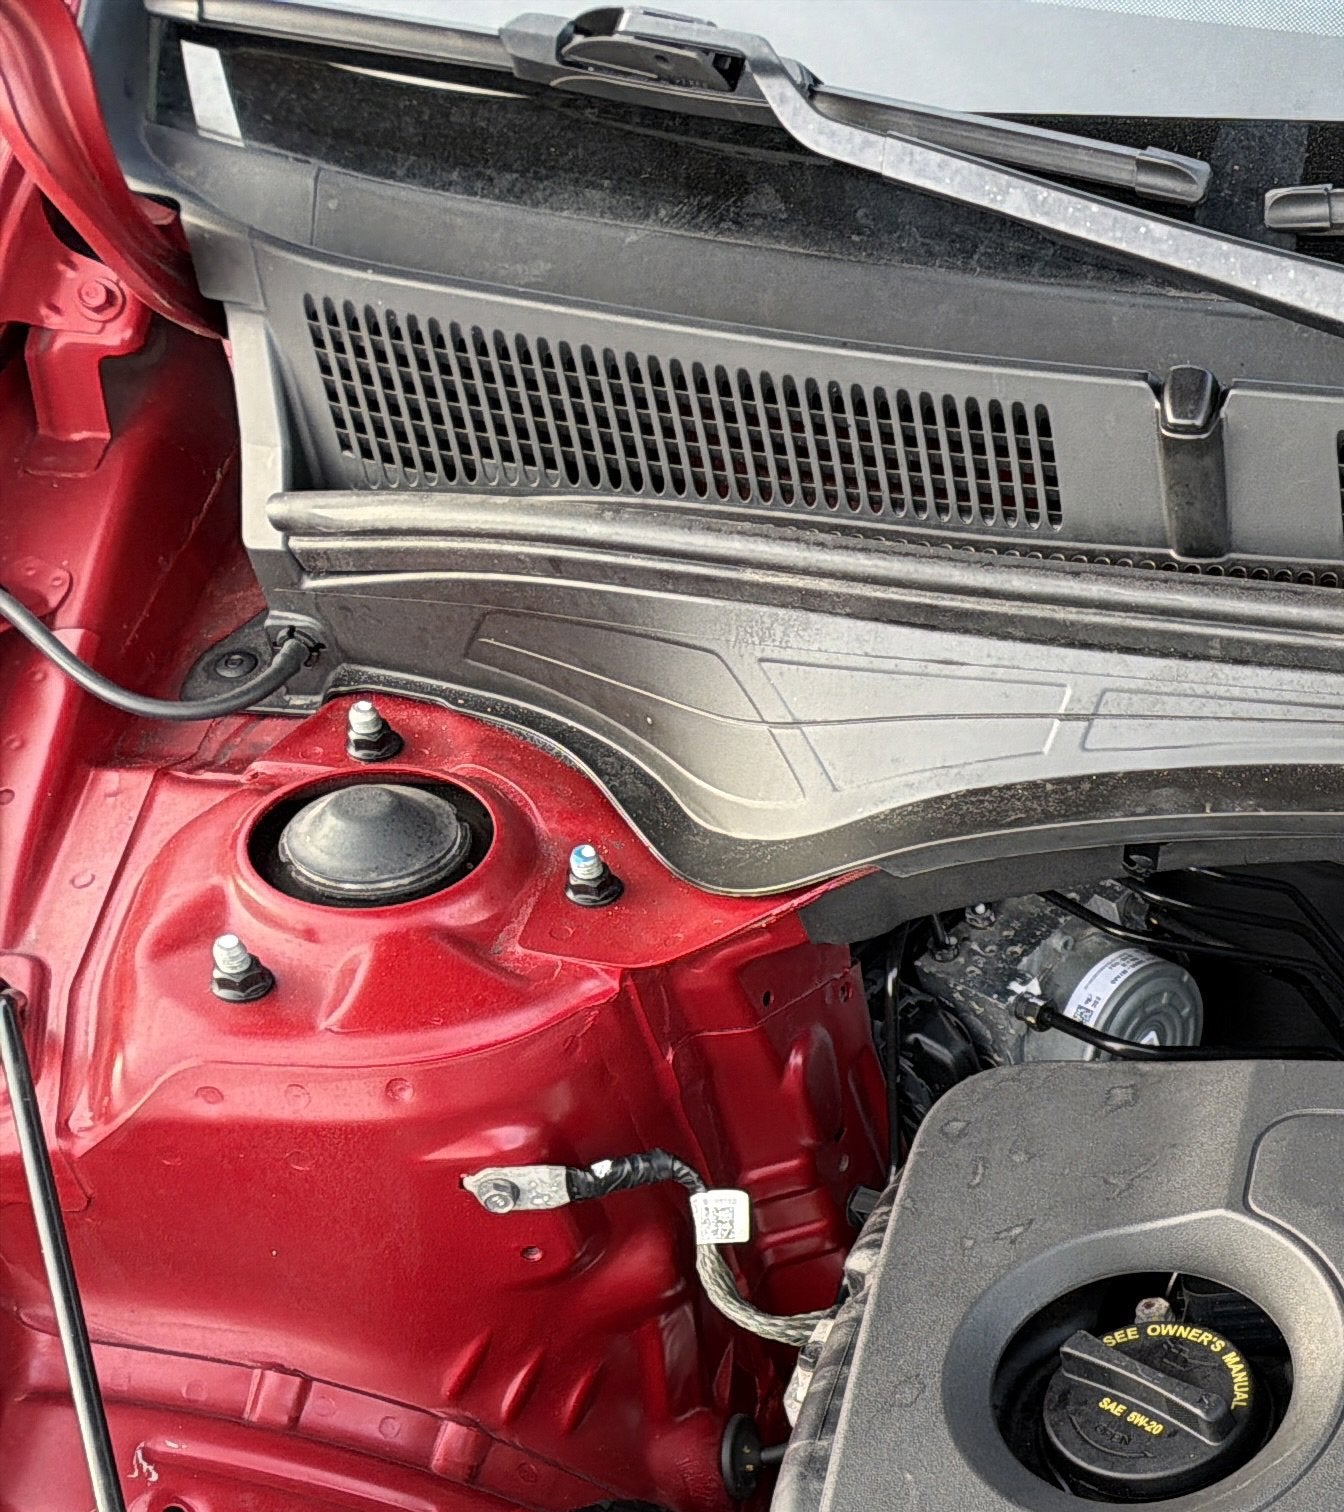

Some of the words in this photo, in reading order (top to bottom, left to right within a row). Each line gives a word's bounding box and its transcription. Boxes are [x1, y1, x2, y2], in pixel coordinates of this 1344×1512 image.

[1103, 1327, 1139, 1347] SEE
[1147, 1324, 1226, 1352] OWNER'S
[1222, 1352, 1249, 1410] MANUAL
[1098, 1398, 1127, 1416] SAE
[1127, 1411, 1164, 1435] 5W-20
